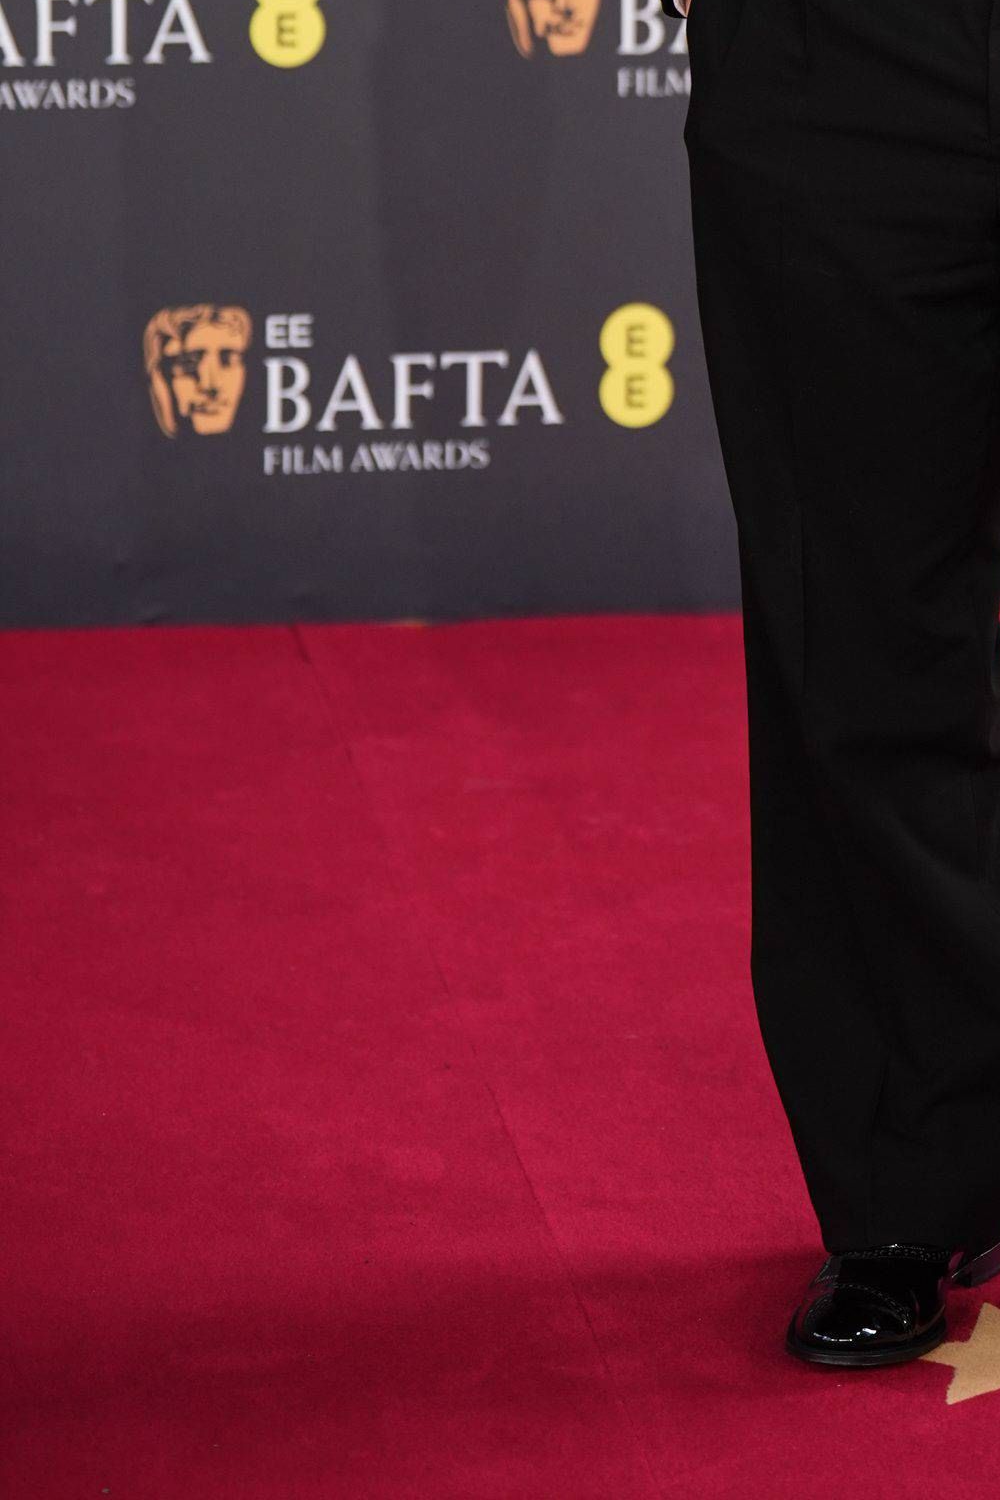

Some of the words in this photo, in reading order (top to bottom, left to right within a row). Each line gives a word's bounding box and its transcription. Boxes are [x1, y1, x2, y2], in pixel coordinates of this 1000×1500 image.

[265, 314, 313, 349] EE
[264, 350, 563, 434] BAFTA
[263, 445, 344, 476] FILM
[350, 440, 490, 473] AWARDS
